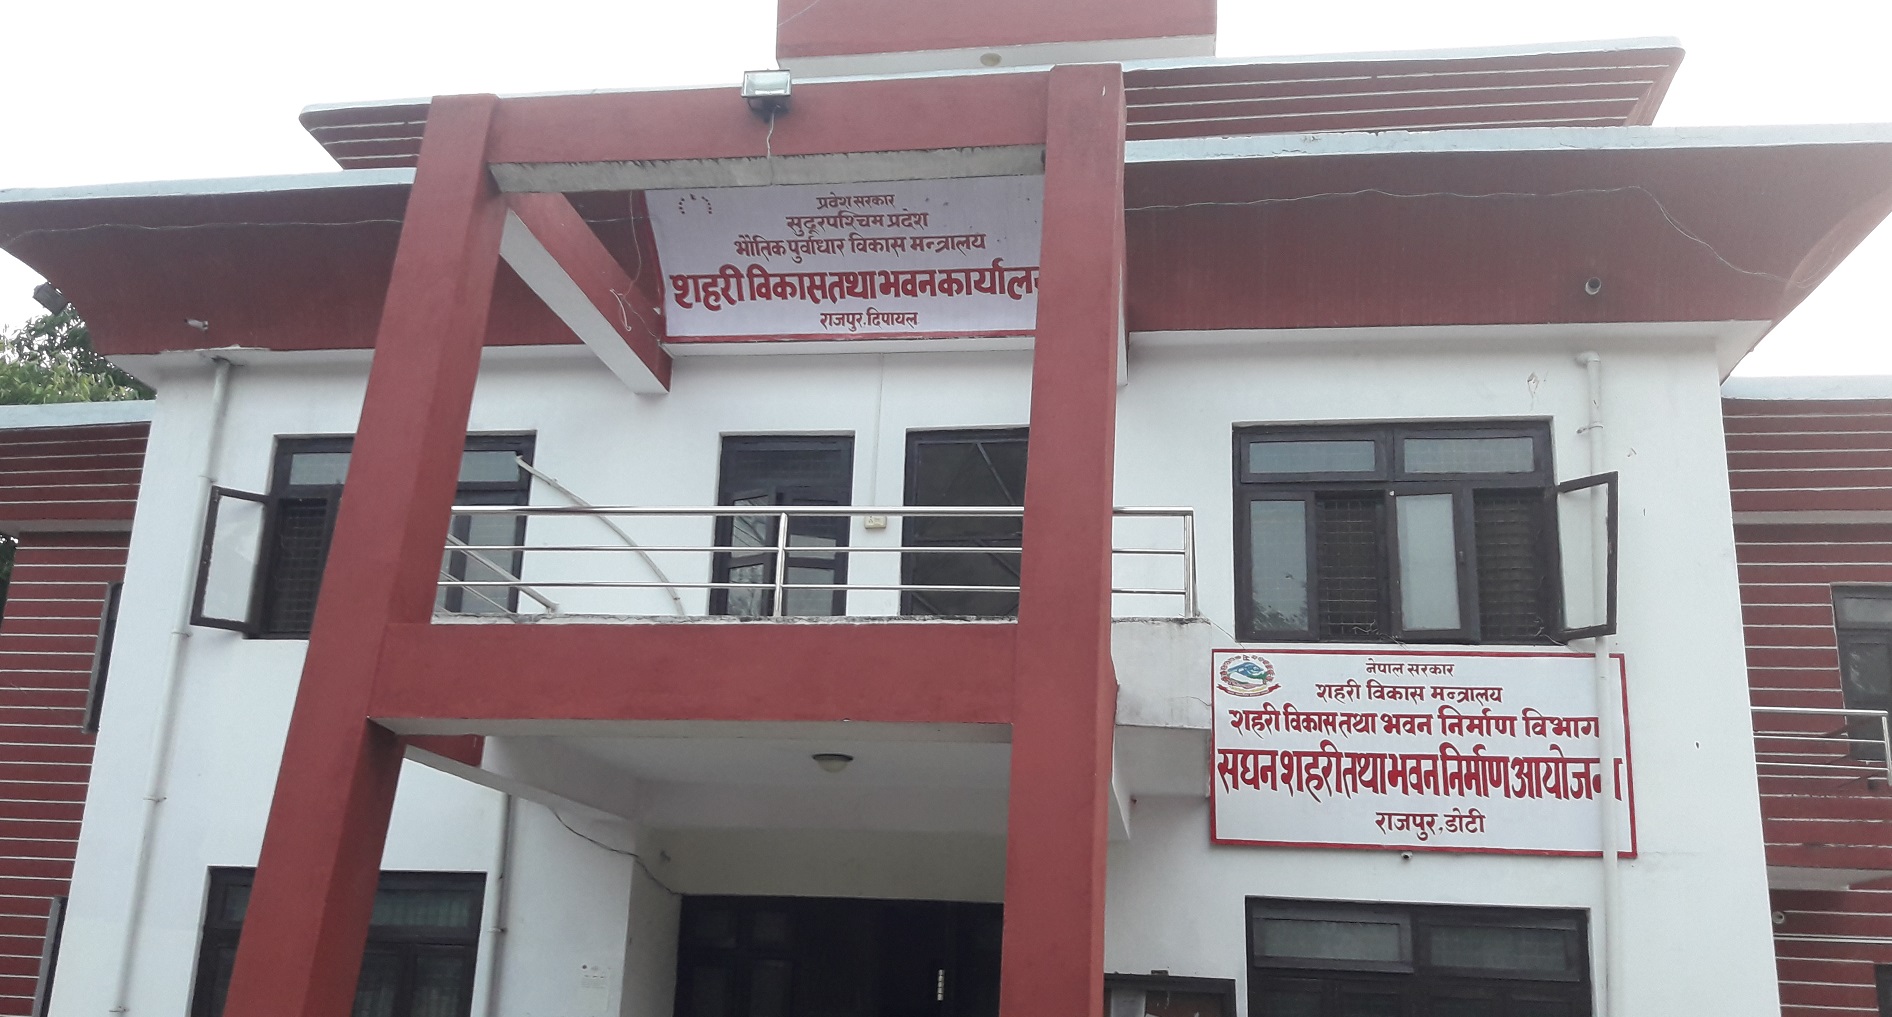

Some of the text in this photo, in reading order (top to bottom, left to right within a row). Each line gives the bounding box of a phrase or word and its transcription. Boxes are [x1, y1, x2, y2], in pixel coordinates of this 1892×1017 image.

[853, 194, 896, 208] सरकार
[848, 232, 906, 257] विकास
[910, 233, 986, 256] मन्त्रालय
[669, 257, 1040, 311] शहरी विकास तथा भवन कार्याल
[1366, 658, 1454, 677] नेपाल सरकार
[1316, 678, 1503, 706] शहरी विकास मन्त्रालय
[1228, 702, 1600, 739] शहरी विकास तथा भवन निर्माण विभाग
[1218, 749, 1278, 794] सघन
[1280, 739, 1343, 803] शहरी
[1342, 752, 1387, 799] तथा
[1387, 753, 1440, 796] भवन
[1440, 742, 1511, 799] निर्माण
